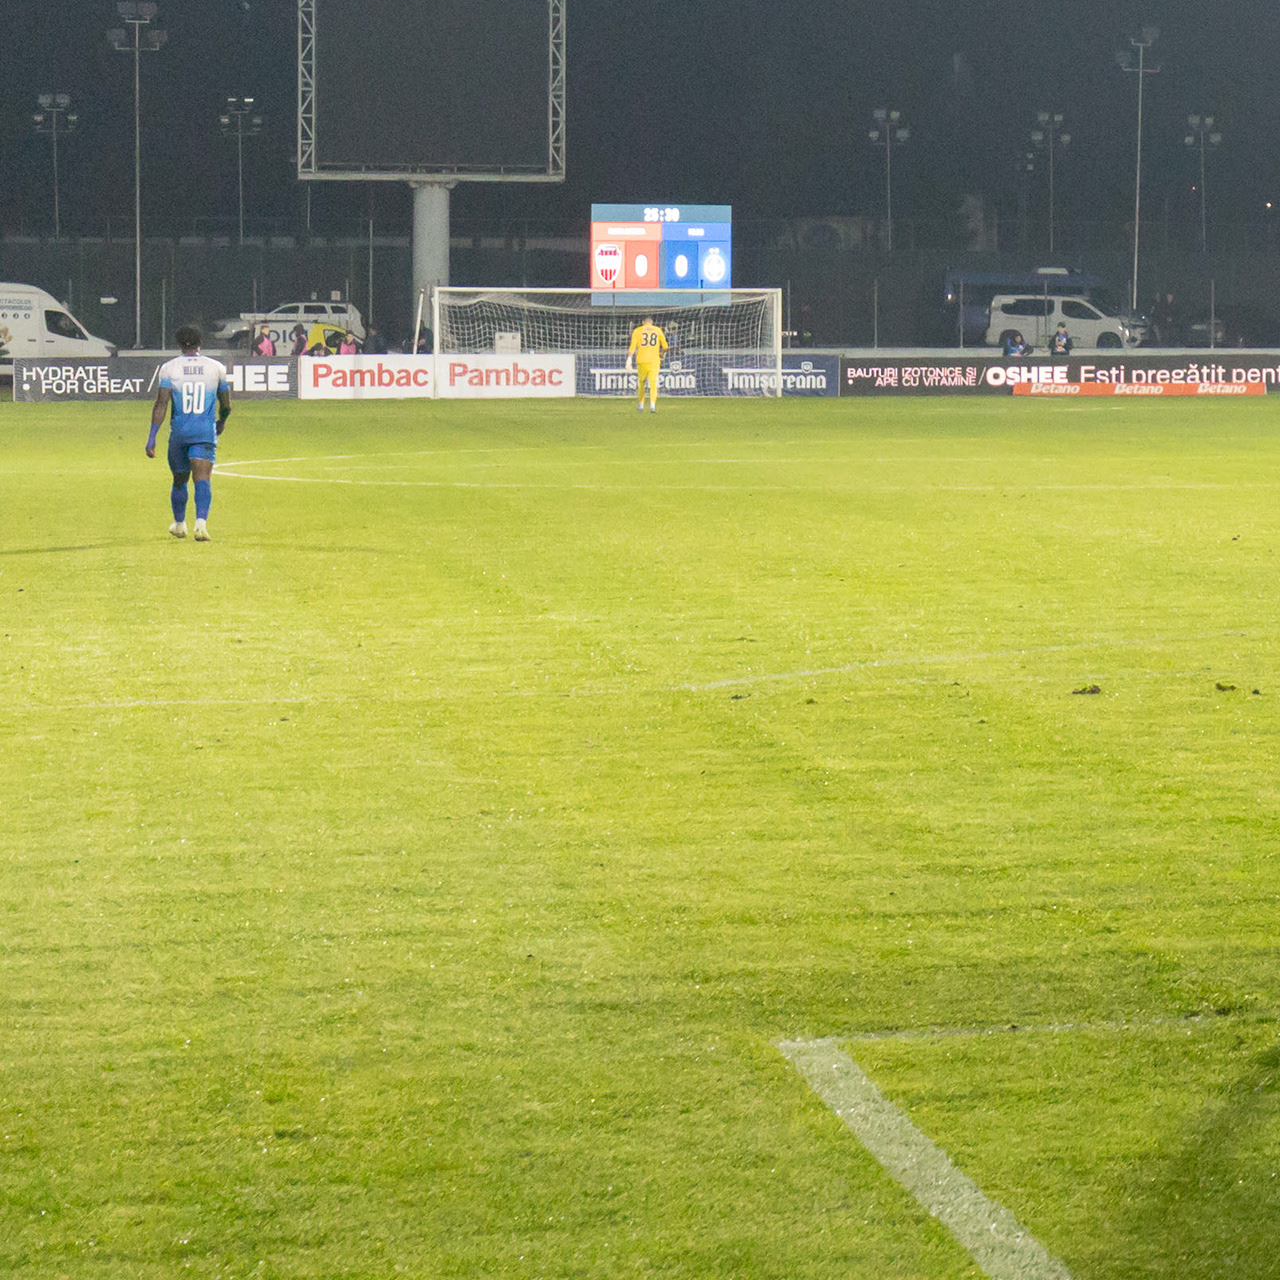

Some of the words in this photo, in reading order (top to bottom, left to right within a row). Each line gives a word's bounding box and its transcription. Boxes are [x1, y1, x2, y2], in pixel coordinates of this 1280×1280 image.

[641, 332, 657, 346] 38
[22, 365, 108, 381] HYDRATE
[226, 364, 290, 392] HEE
[313, 363, 429, 388] Pambac
[449, 363, 563, 387] Pambac
[847, 367, 898, 377] BAUTURI
[902, 367, 962, 377] IZOTONICE
[986, 365, 1069, 386] OSHEE
[41, 379, 79, 394] FOR
[83, 378, 144, 394] GREAT
[874, 377, 898, 387] APE
[902, 377, 919, 387] CU
[923, 377, 976, 386] VITAMINE
[1030, 383, 1080, 394] Betano
[1114, 383, 1163, 394] Betano
[1197, 383, 1247, 394] Betano
[182, 381, 206, 414] 60
